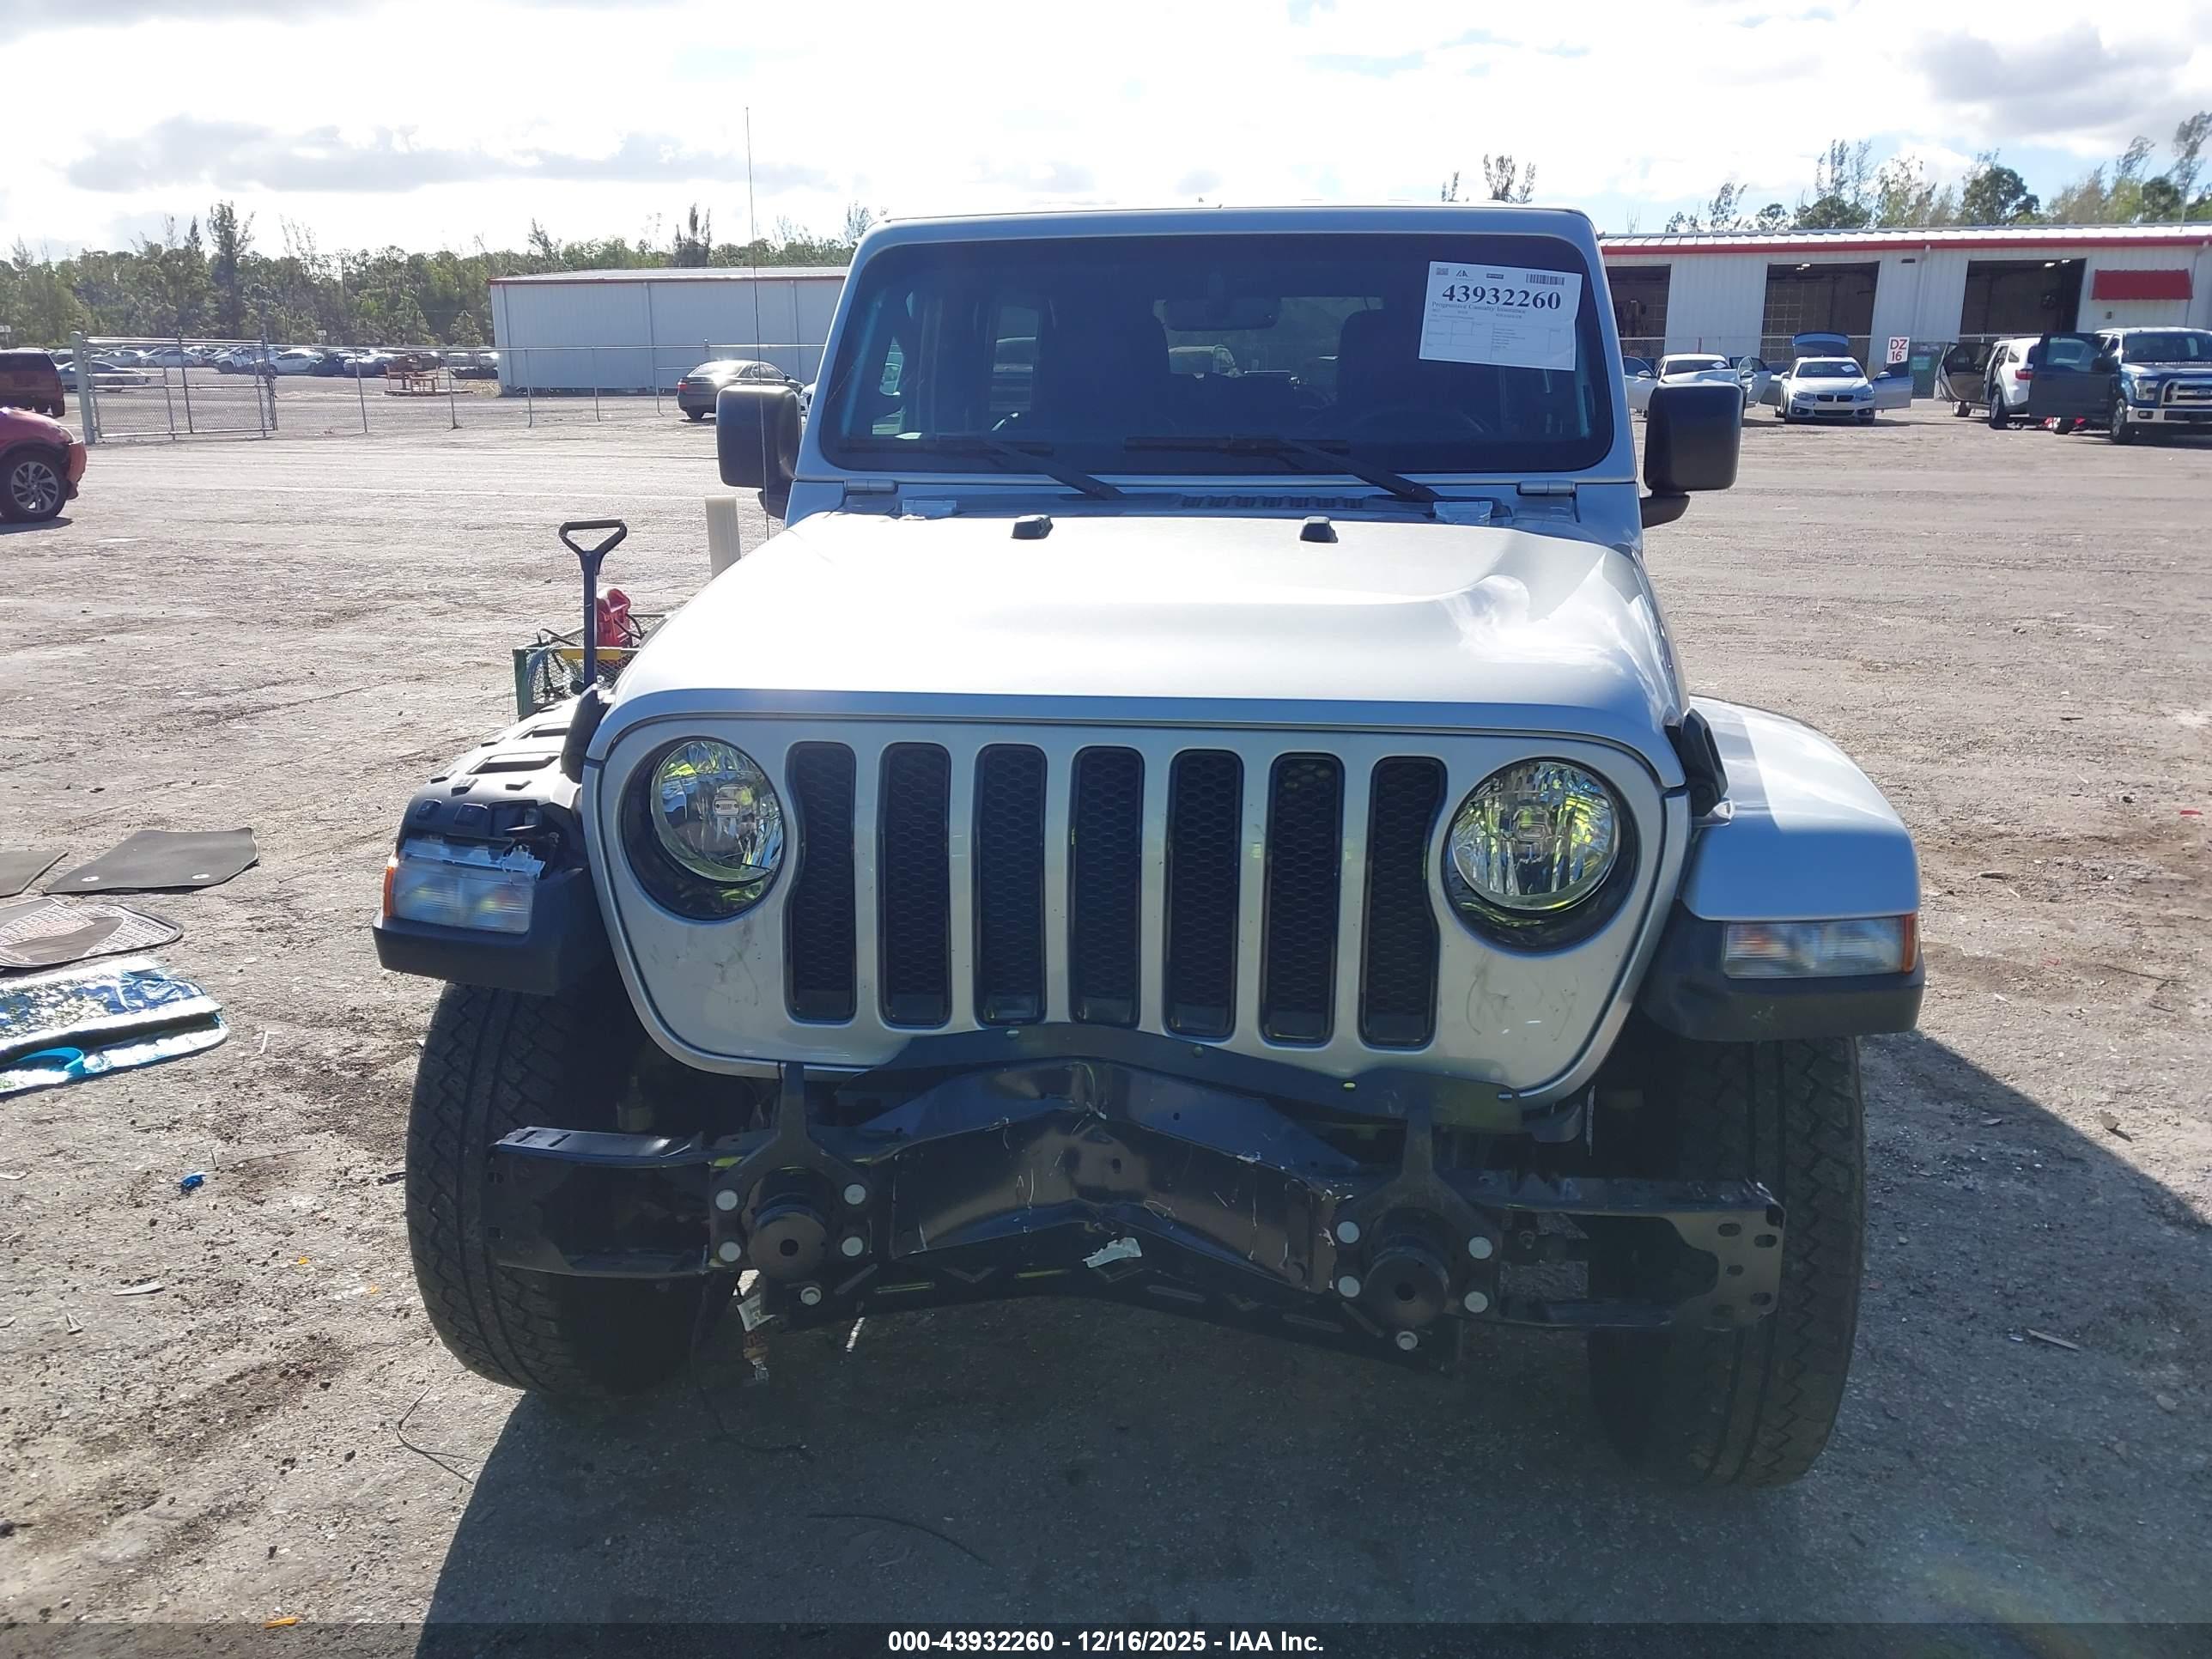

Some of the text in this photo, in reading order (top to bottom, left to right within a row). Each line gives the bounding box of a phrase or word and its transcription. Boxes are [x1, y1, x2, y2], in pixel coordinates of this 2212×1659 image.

[1442, 284, 1561, 310] 43932260
[1431, 301, 1467, 310] Progrive
[1890, 339, 1908, 349] DZ
[1892, 351, 1902, 361] 16
